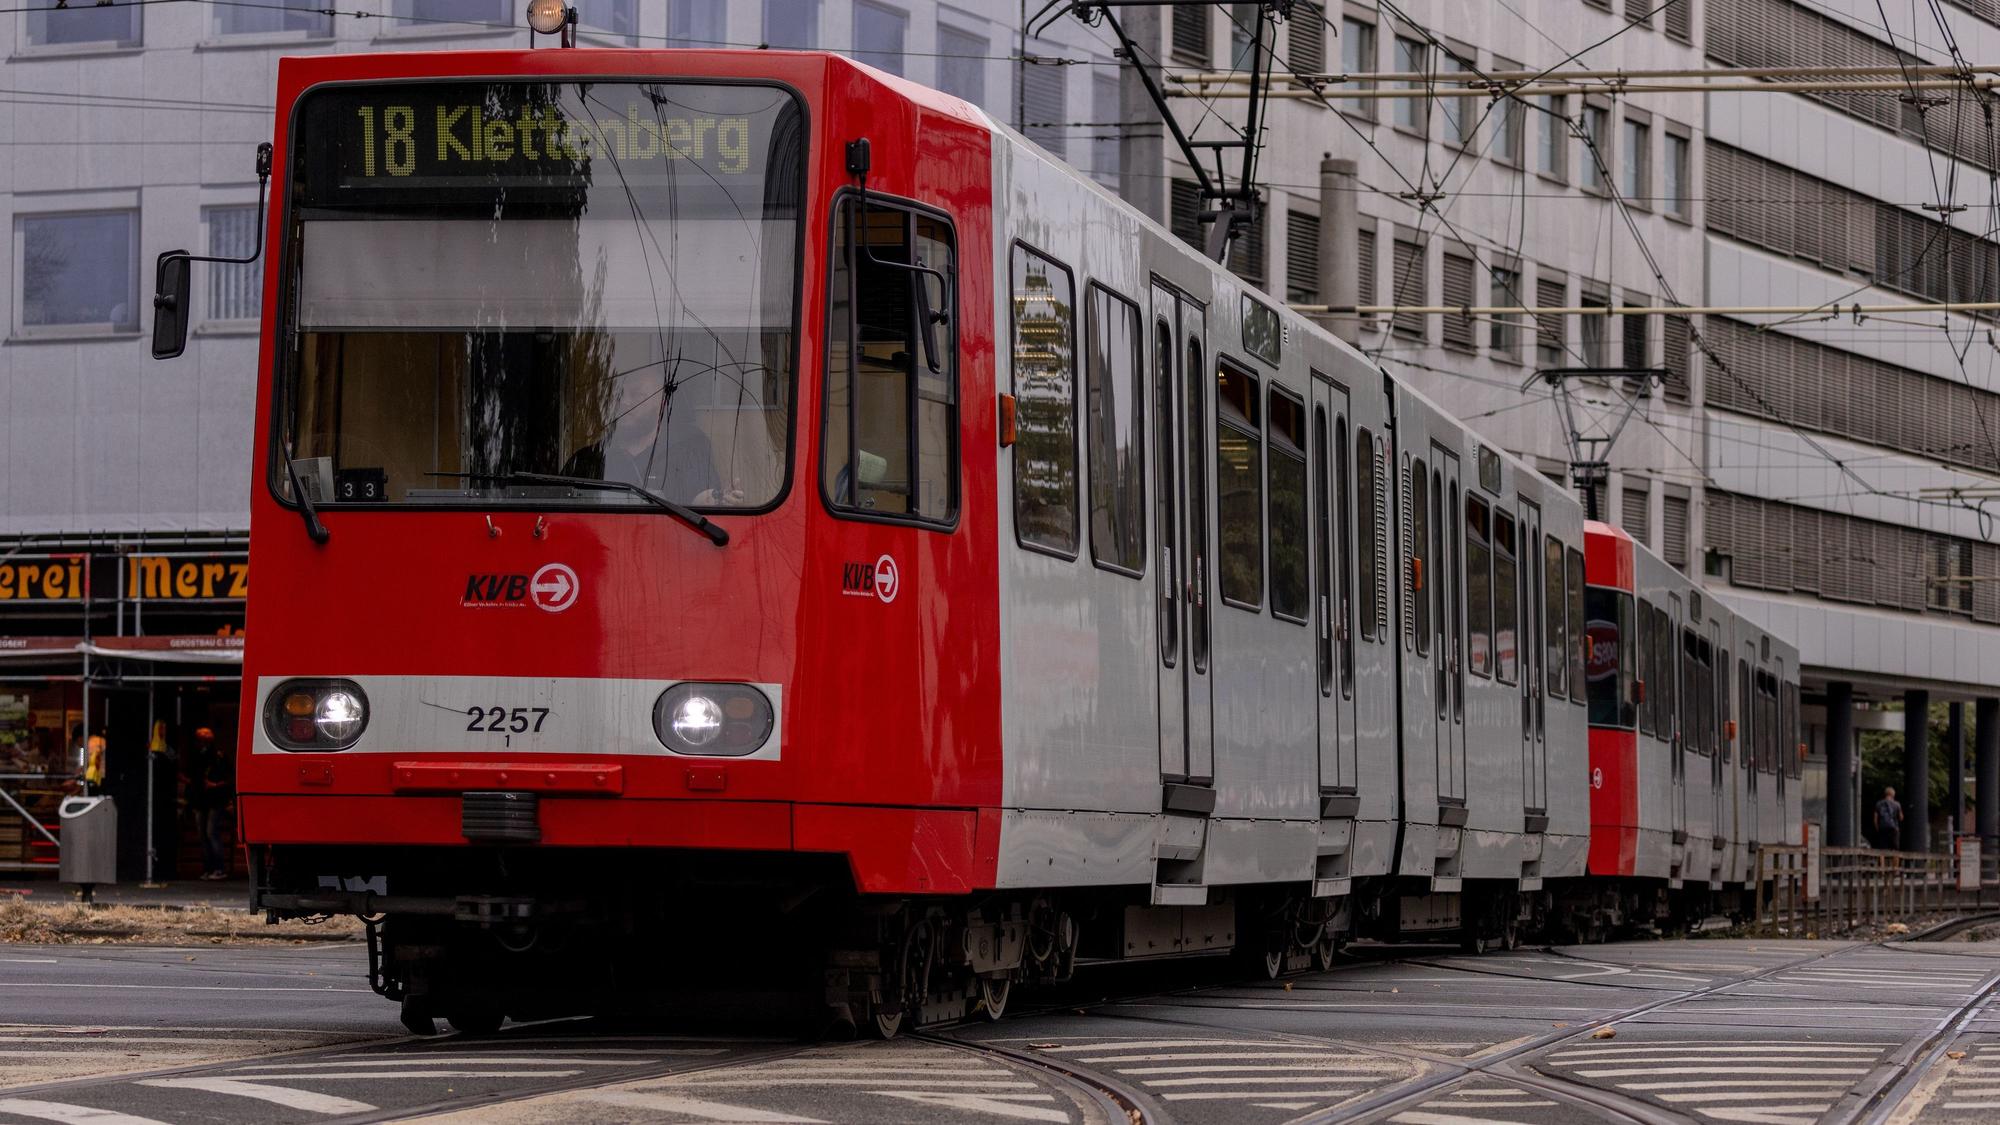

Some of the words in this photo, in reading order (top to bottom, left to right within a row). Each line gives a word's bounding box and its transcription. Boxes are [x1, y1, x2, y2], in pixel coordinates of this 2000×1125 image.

[358, 106, 416, 177] 18
[436, 104, 749, 174] Klettenberg
[464, 575, 529, 601] KVB
[843, 562, 874, 591] KVB
[467, 706, 550, 733] 2257
[505, 734, 511, 748] 1
